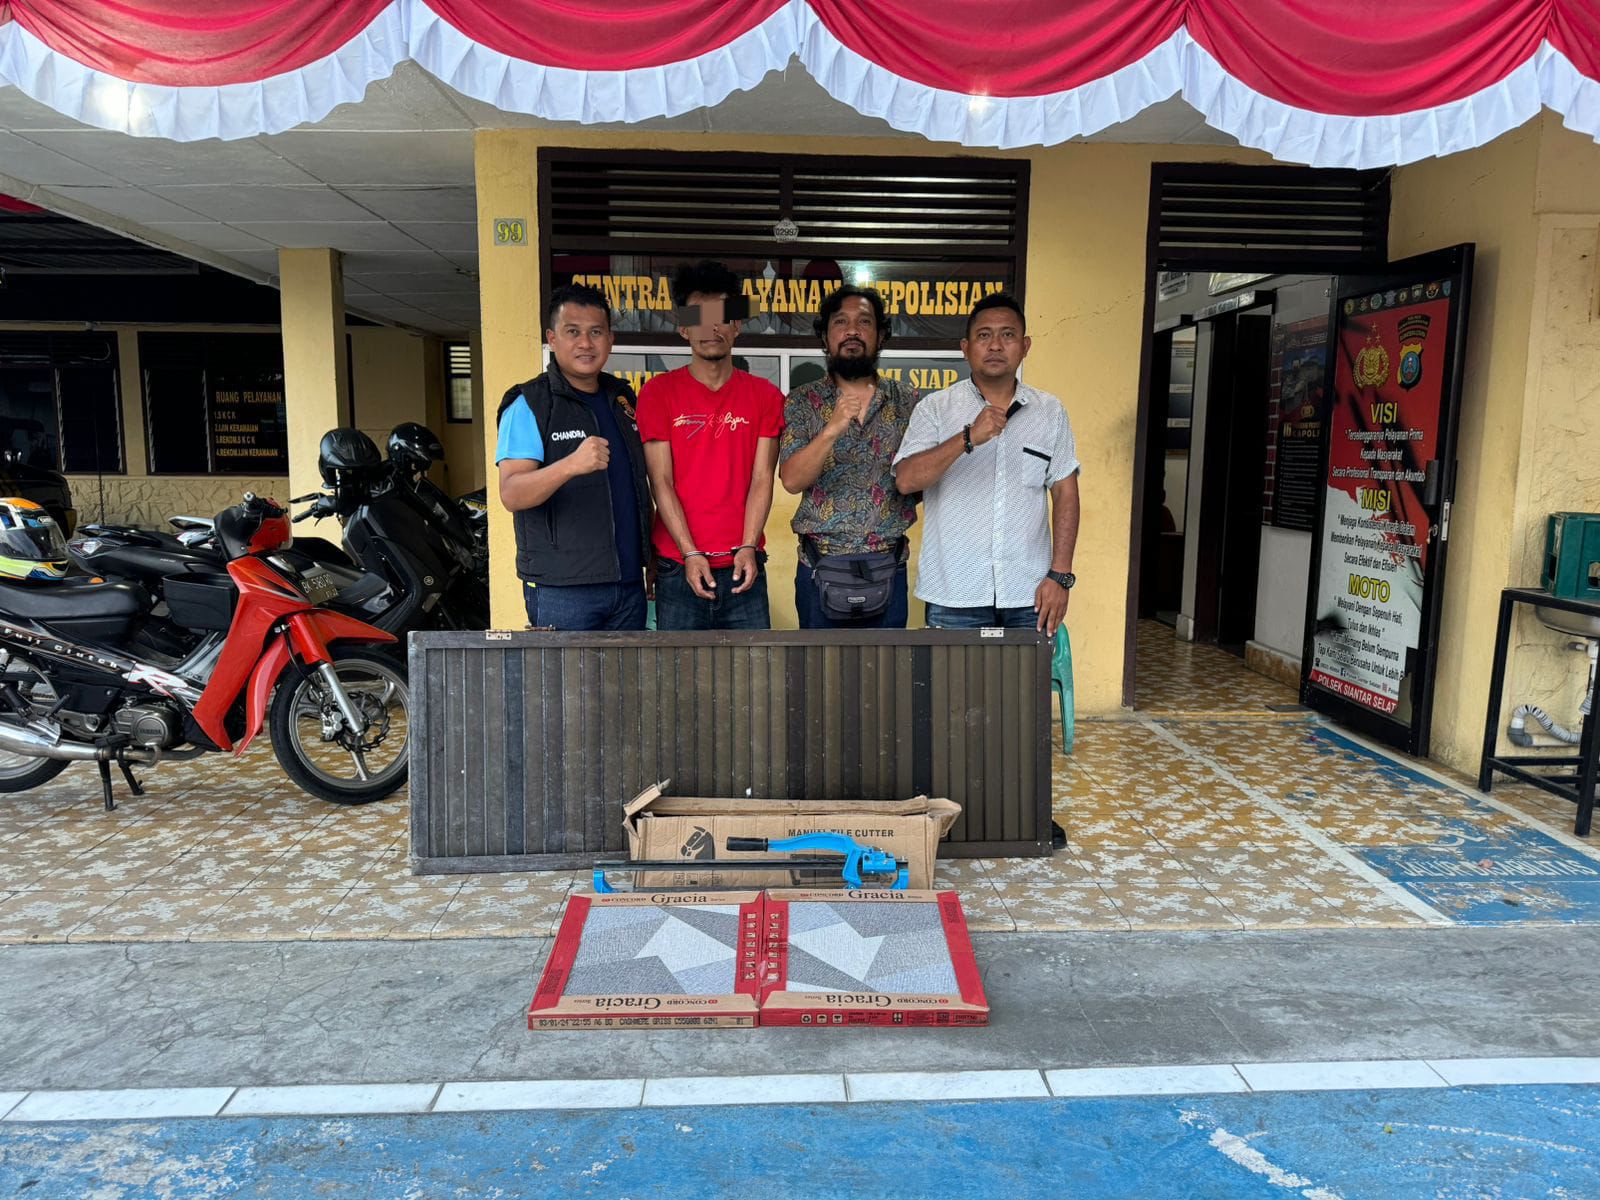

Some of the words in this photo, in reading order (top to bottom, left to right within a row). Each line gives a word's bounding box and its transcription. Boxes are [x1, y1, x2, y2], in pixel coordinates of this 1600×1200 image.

[497, 221, 523, 243] 99
[216, 391, 239, 403] RUANG
[243, 391, 281, 403] PELAYANAN
[1371, 402, 1398, 423] VISI
[551, 430, 586, 442] CHANDRA
[1361, 488, 1392, 511] MISI
[1348, 573, 1390, 603] MOTO
[1317, 674, 1342, 693] POLSEK
[1343, 683, 1372, 706] SIANTAR
[855, 829, 894, 837] CUTTER
[651, 893, 707, 905] Gracia
[848, 889, 905, 900] Gracia
[595, 996, 661, 1011] Gracia
[826, 994, 891, 1008] Gracia
